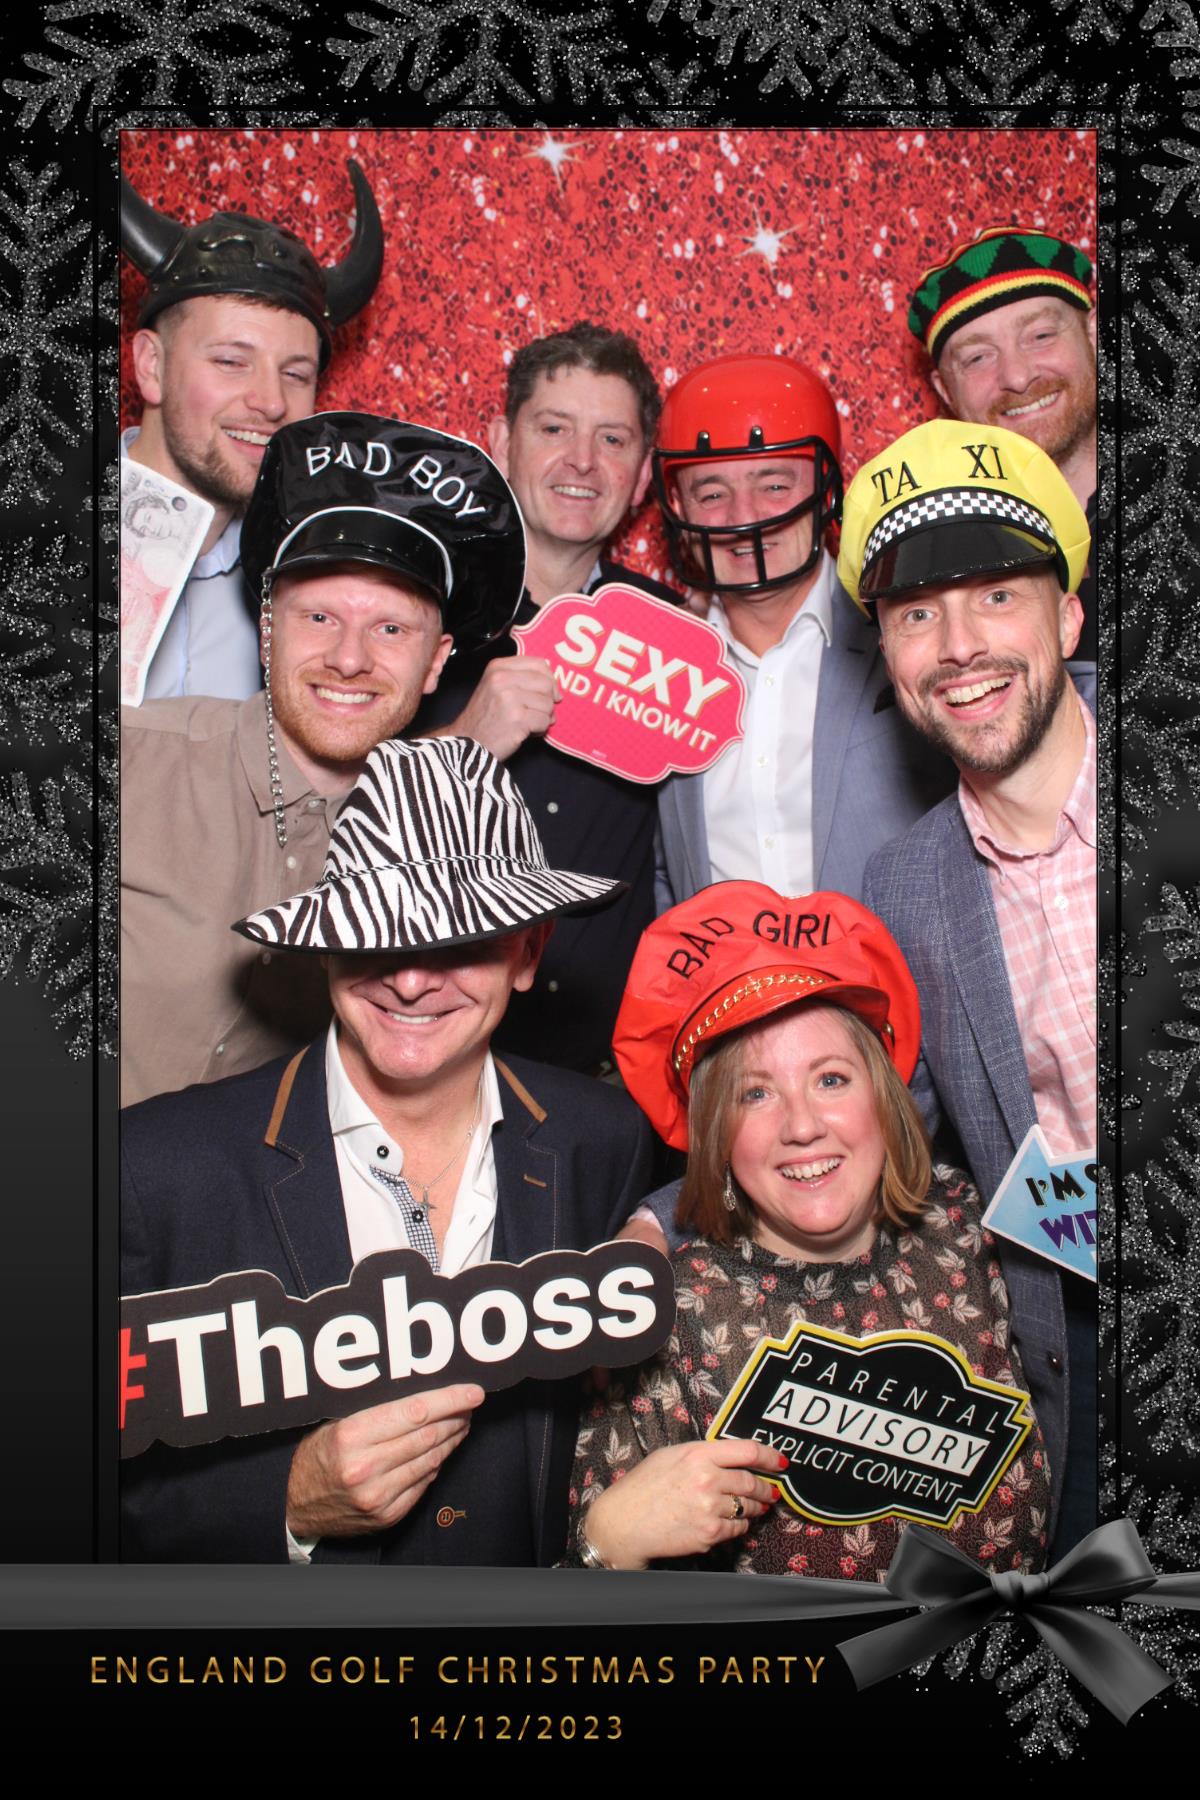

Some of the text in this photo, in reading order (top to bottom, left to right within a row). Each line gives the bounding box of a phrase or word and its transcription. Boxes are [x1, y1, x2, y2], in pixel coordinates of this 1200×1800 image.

[306, 441, 487, 519] BAD BOY
[545, 659, 717, 752] ND I KNOW IT
[554, 614, 732, 720] SEXY
[666, 917, 735, 980] BAD
[1025, 1168, 1087, 1208] I'M
[766, 1387, 990, 1470] ADVISORY
[790, 1351, 1000, 1434] PARENTAL
[752, 1428, 963, 1504] EXPLICIT CONTENT
